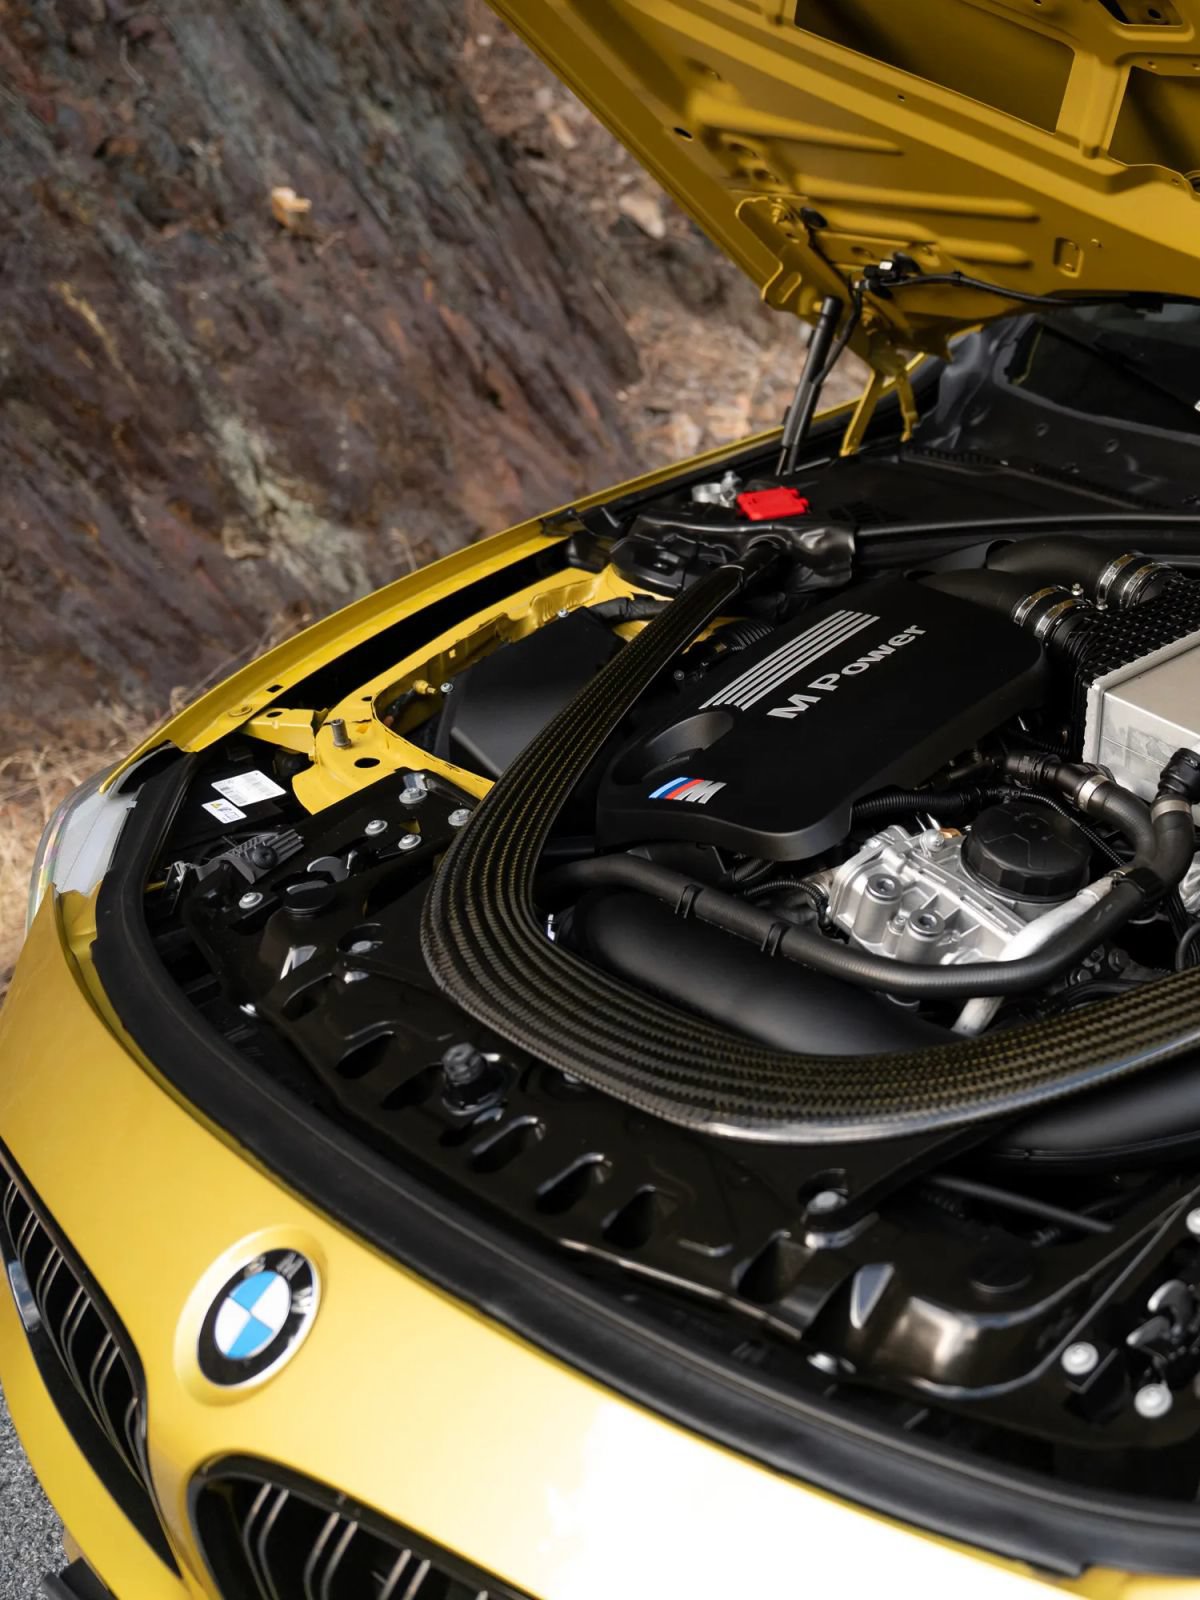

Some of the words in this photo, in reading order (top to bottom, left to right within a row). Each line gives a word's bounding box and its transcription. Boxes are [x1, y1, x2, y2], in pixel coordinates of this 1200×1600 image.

[767, 693, 821, 719] M
[807, 624, 927, 691] Power
[672, 779, 728, 805] M
